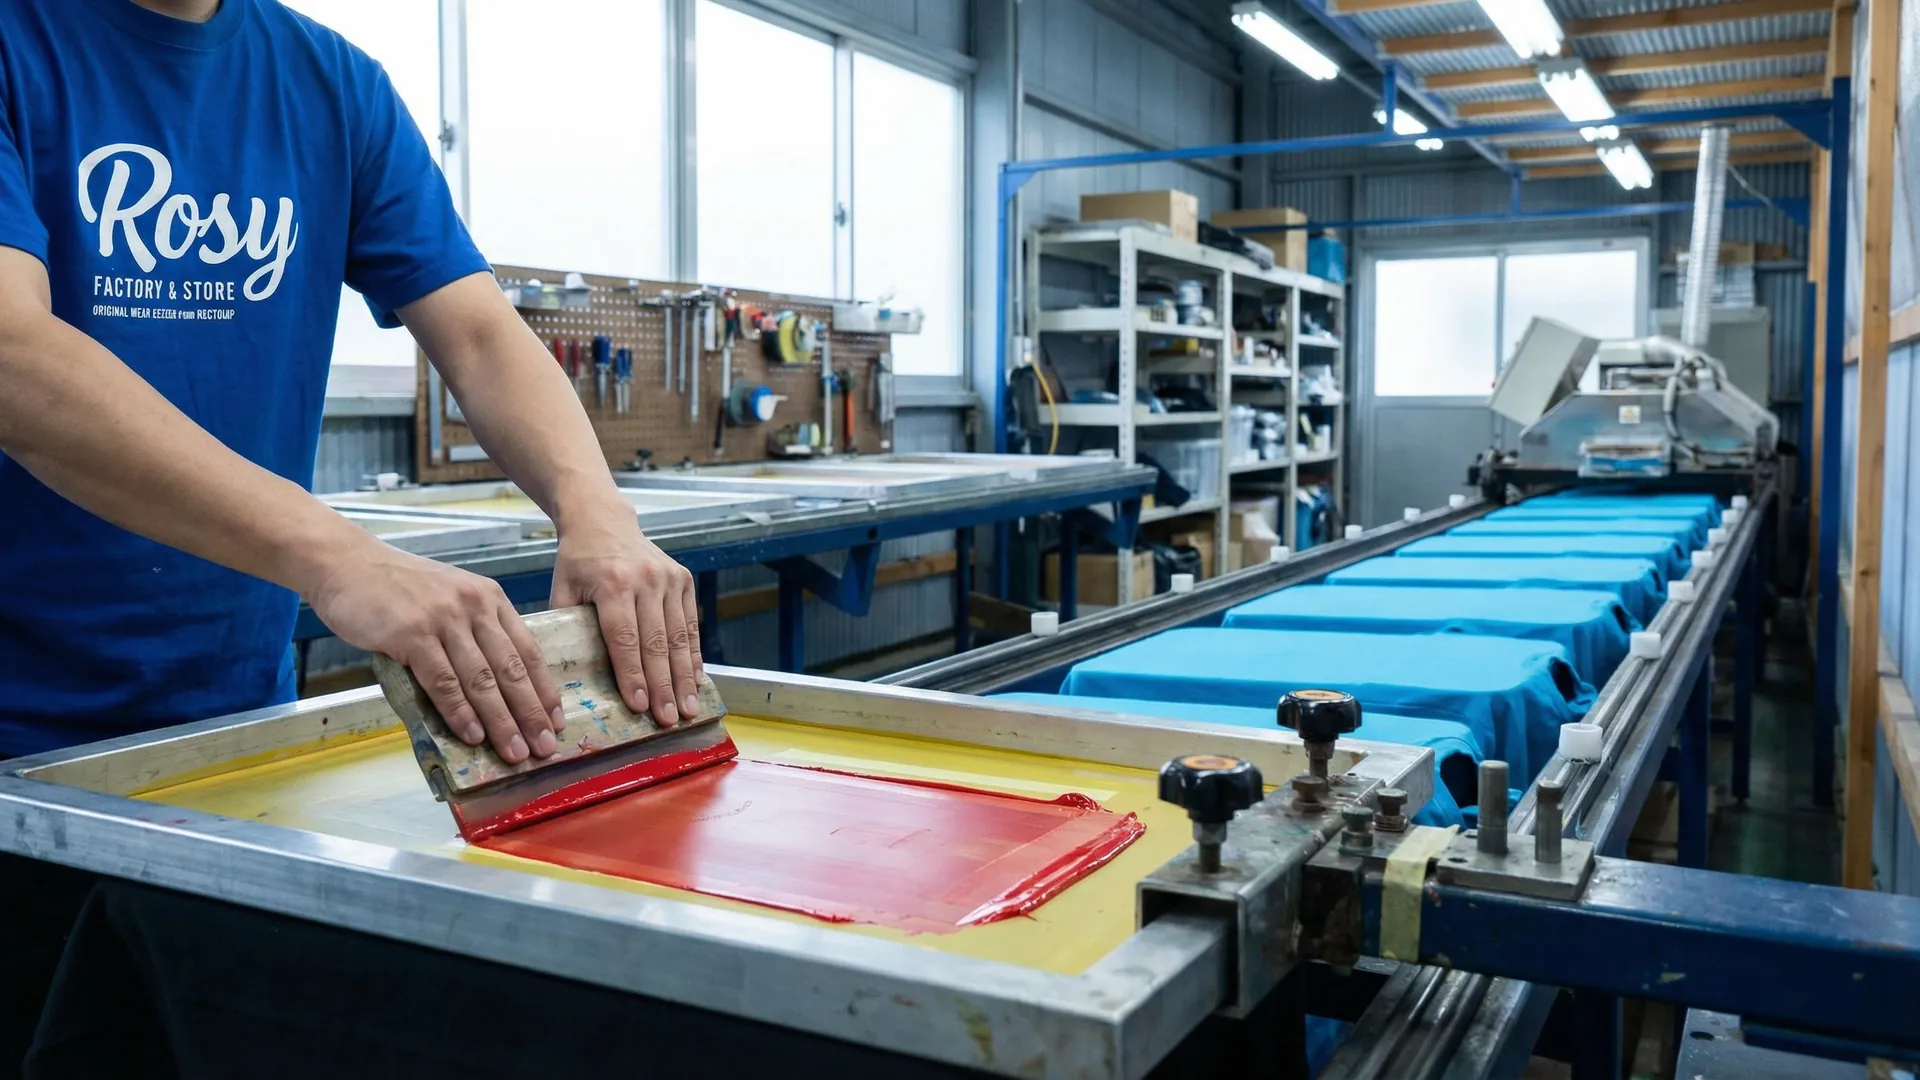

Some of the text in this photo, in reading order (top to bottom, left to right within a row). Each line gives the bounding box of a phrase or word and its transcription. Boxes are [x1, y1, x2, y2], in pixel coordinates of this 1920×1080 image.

[78, 142, 299, 301] Rosy
[94, 275, 236, 301] FACTORY & STORE
[92, 304, 129, 318] ORIGINAL
